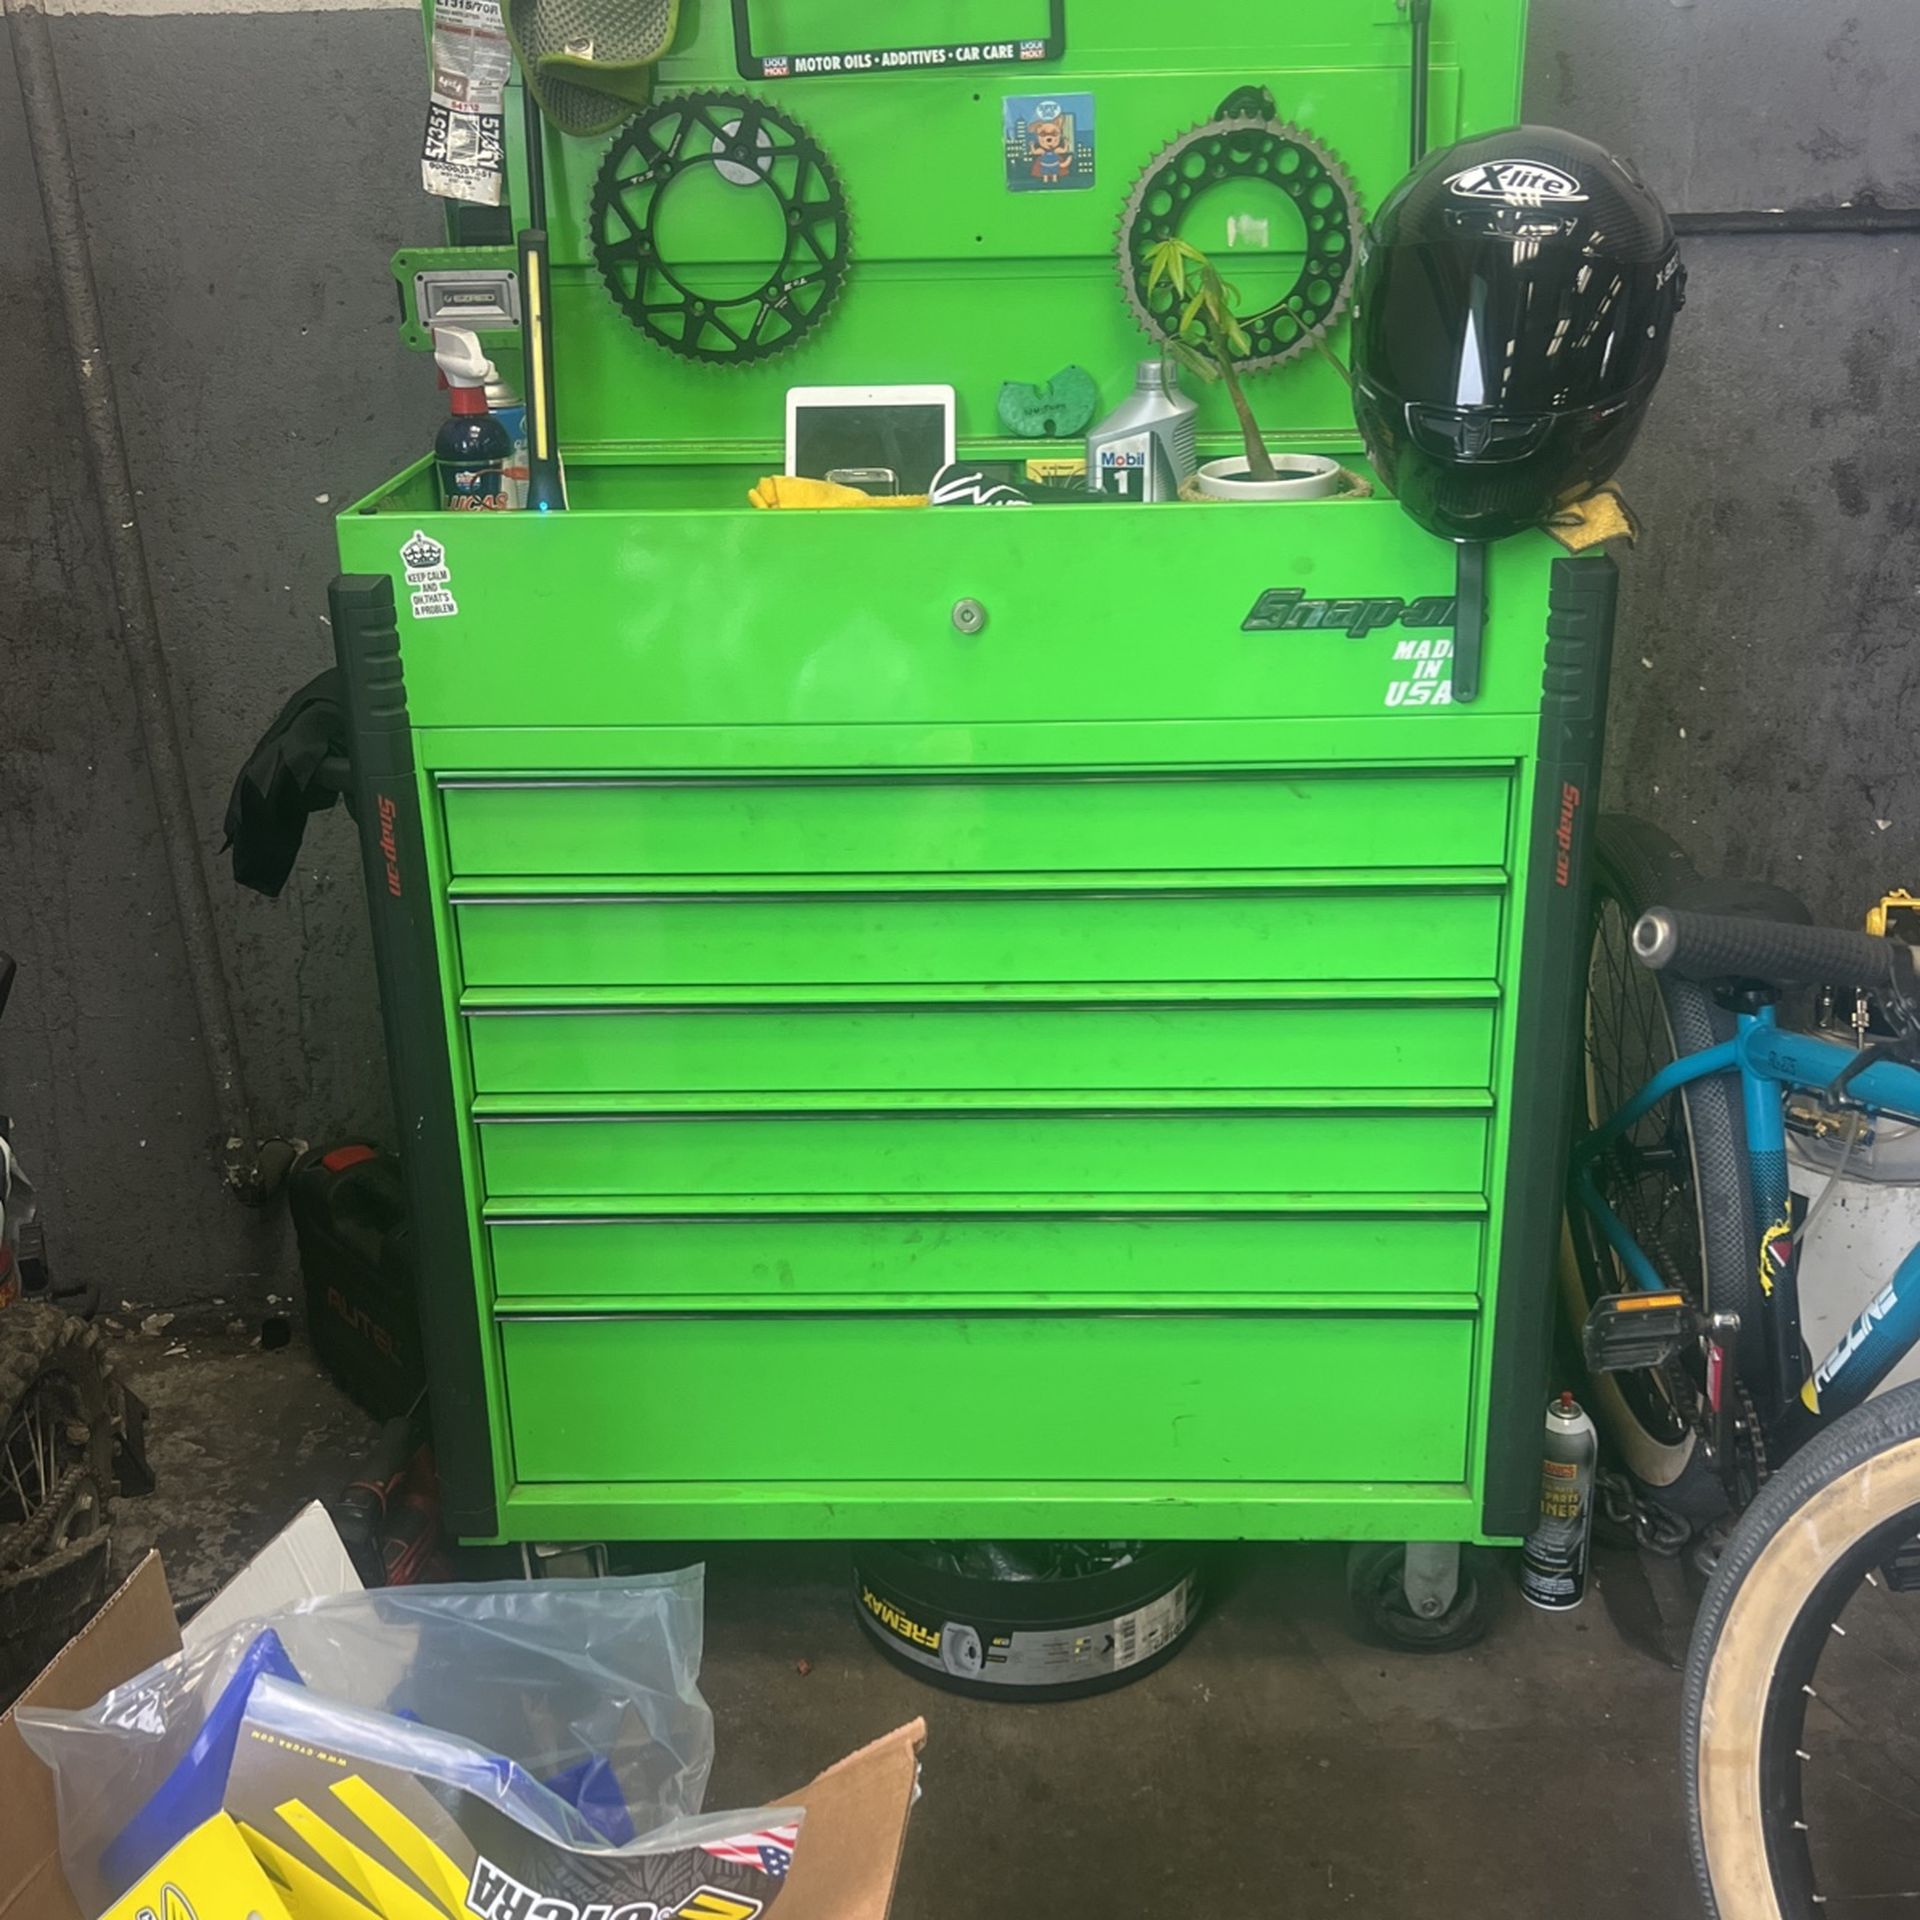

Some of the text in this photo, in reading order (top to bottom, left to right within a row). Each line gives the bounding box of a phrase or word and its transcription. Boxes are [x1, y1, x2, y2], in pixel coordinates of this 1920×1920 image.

[795, 44, 1014, 72] MOTOR OILS ADDITIVES CAR CARE
[424, 105, 449, 160] 57351
[1465, 165, 1565, 195] X-lite
[1101, 452, 1145, 466] Mobil
[1114, 469, 1129, 494] 1
[445, 492, 509, 511] LUCAS
[407, 570, 448, 583] KEEP CALM
[422, 583, 438, 592] AND
[415, 603, 455, 616] A PROBLEM
[1392, 639, 1454, 660] MAD
[1412, 660, 1443, 679] IN
[1384, 680, 1453, 707] USA
[377, 794, 402, 897] Snap-on
[1556, 782, 1580, 887] Snap-on
[862, 1585, 941, 1650] FREMAX
